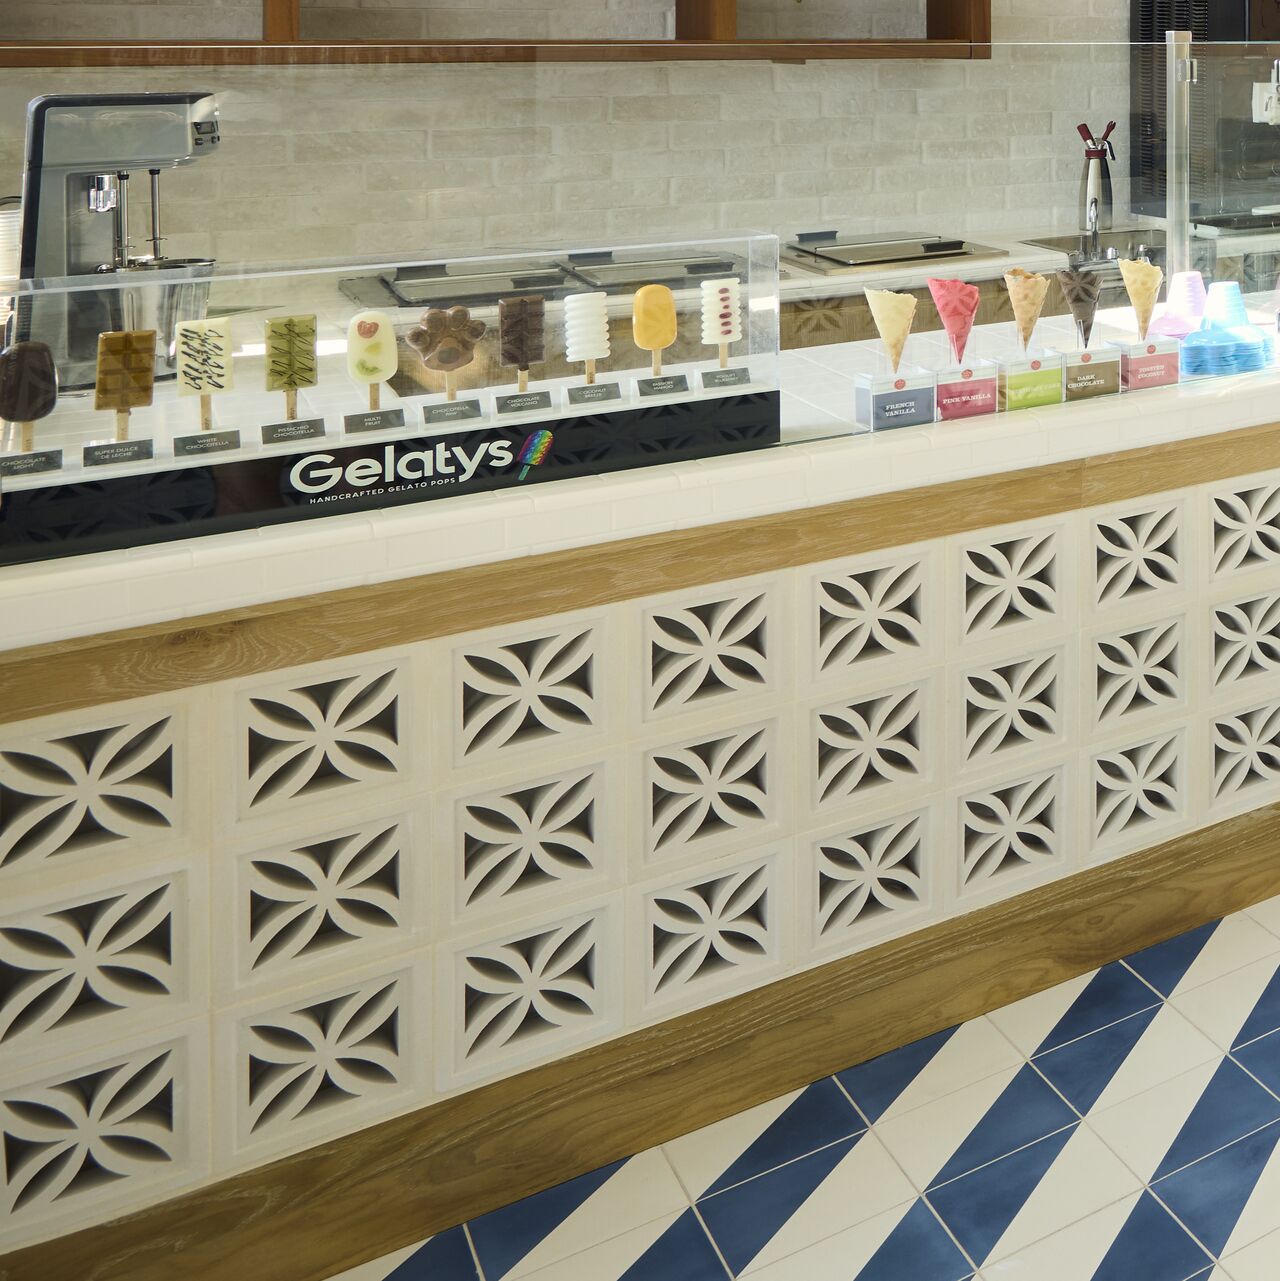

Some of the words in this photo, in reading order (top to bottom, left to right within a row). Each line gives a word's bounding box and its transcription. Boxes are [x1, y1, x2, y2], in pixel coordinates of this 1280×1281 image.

[1077, 374, 1096, 382] DARK
[1067, 379, 1105, 389] CHOCOLATE
[961, 393, 991, 402] VANILLA
[885, 401, 915, 410] FRENCH
[885, 408, 916, 417] VANILLA
[289, 439, 514, 494] Gelatys
[309, 488, 384, 504] HANDCRAFTED
[387, 481, 427, 493] GELATO
[430, 477, 456, 487] POPS
